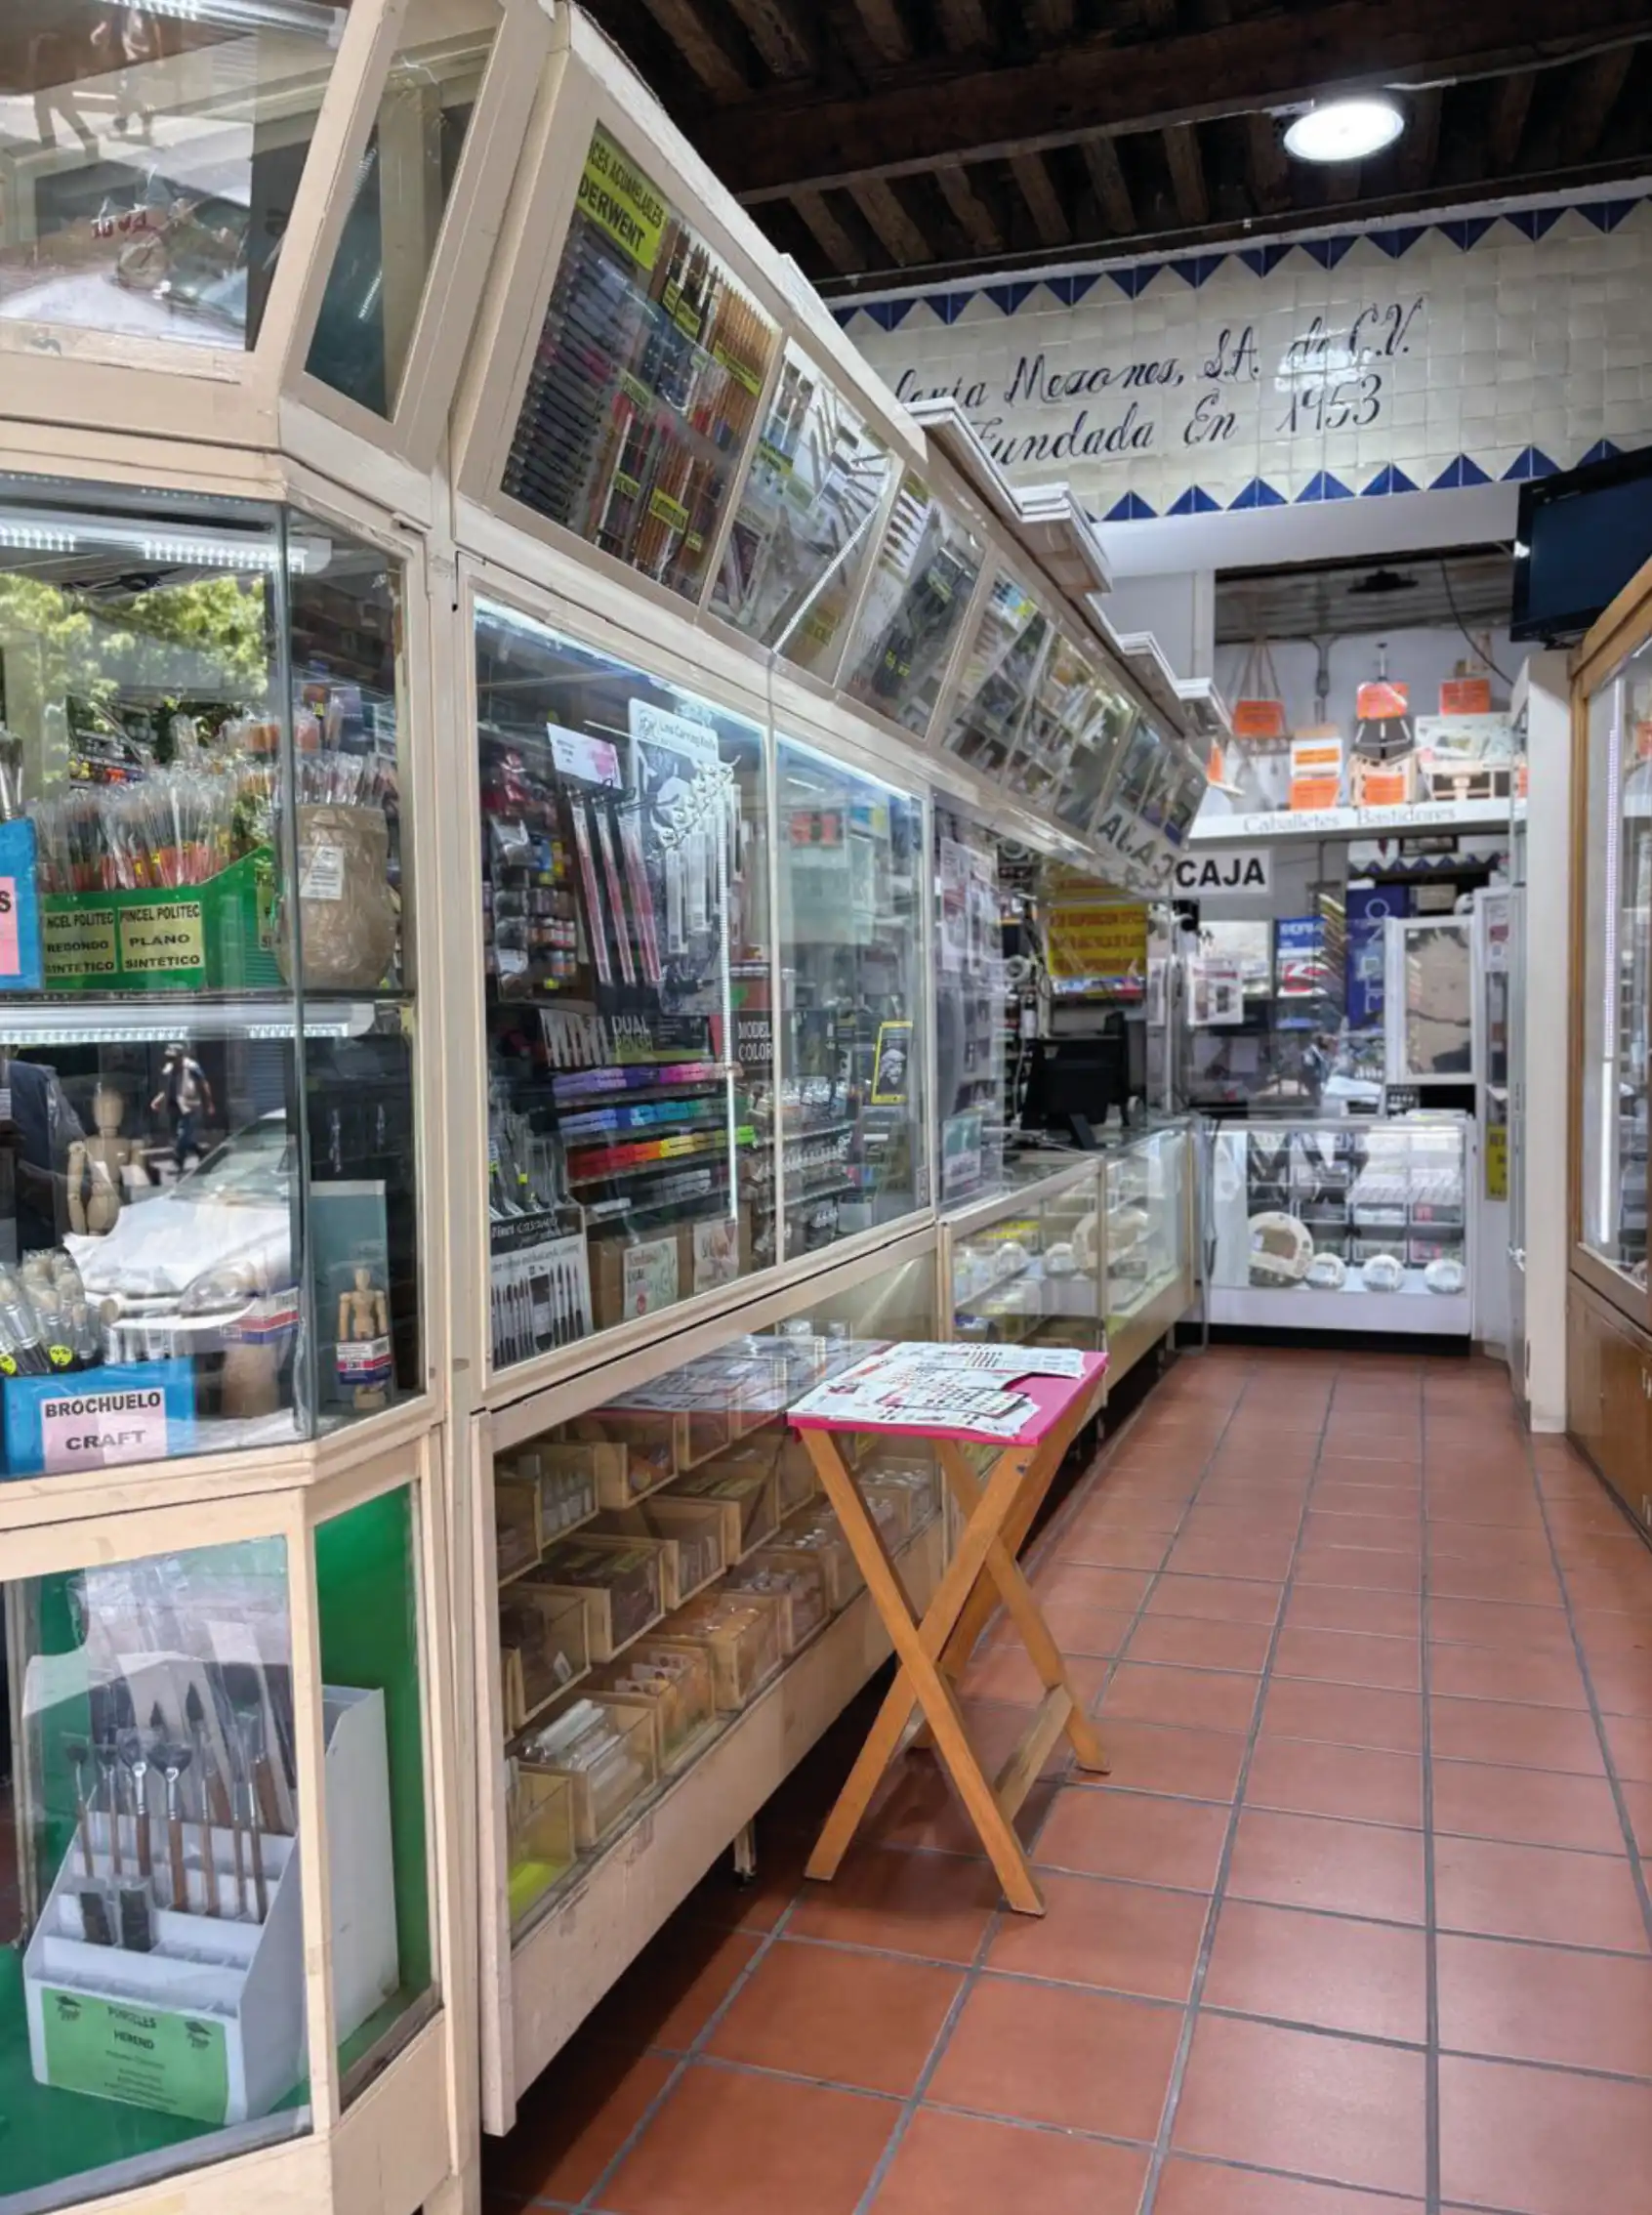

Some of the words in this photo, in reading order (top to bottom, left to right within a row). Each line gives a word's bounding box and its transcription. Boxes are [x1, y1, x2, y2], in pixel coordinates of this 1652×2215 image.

[578, 172, 645, 252] DERWENT
[971, 400, 1155, 466] Fundada
[1183, 388, 1238, 445] En
[1275, 373, 1383, 432] 1953
[1243, 814, 1341, 834] Caballetes
[1356, 807, 1457, 826] Bastidores
[1175, 857, 1266, 888] CAJA
[73, 911, 114, 927] POLITEC
[157, 904, 200, 920] POLITEC
[47, 940, 109, 953] REDONDO
[129, 934, 190, 948] PLANO
[125, 954, 200, 969] SINTETICO
[611, 1015, 651, 1036] DUAL
[738, 1021, 771, 1040] MODEL
[738, 1042, 773, 1062] COLOR
[45, 1391, 161, 1418] BROCHUELO
[65, 1429, 146, 1451] CRAFT
